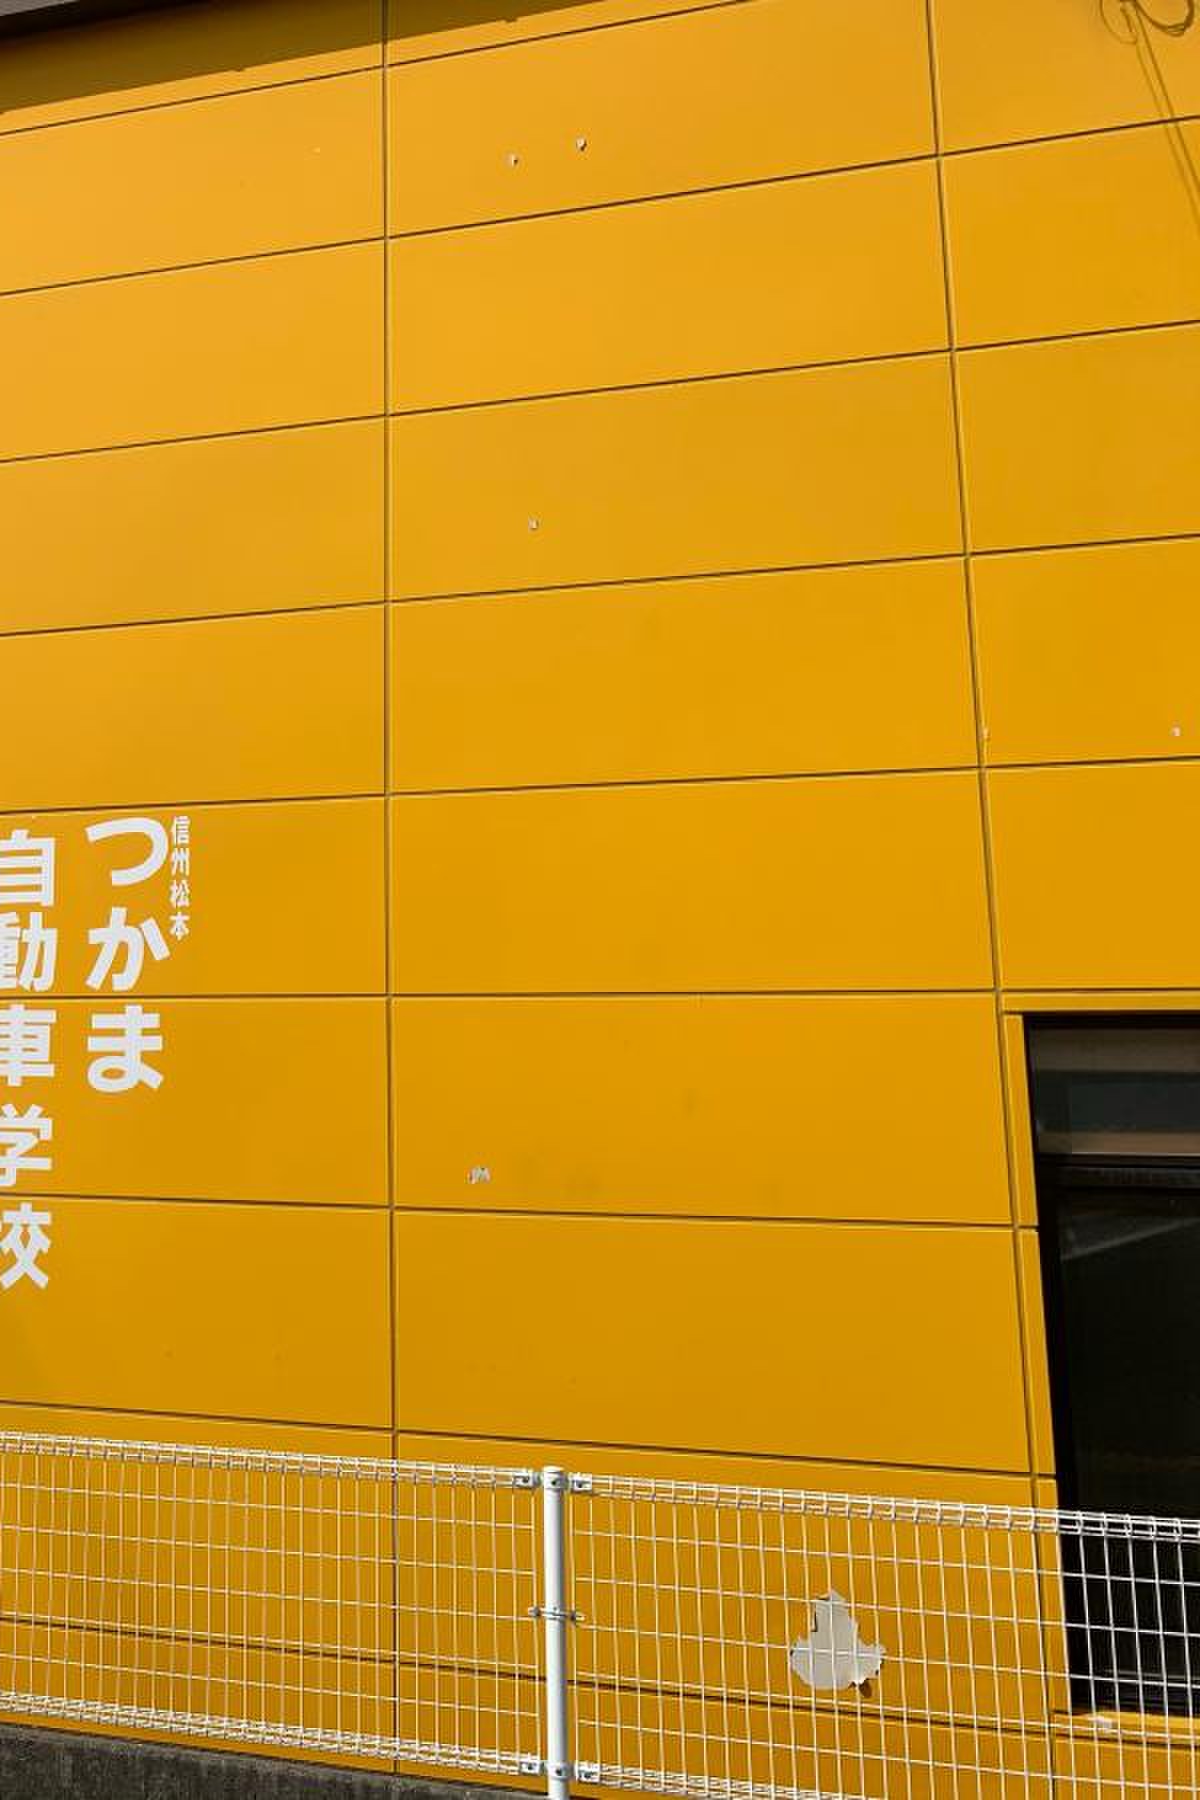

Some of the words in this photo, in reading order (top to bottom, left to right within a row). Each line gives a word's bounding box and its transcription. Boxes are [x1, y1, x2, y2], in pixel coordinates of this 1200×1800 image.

[85, 816, 171, 1093] つかま
[170, 815, 191, 941] 信州松本
